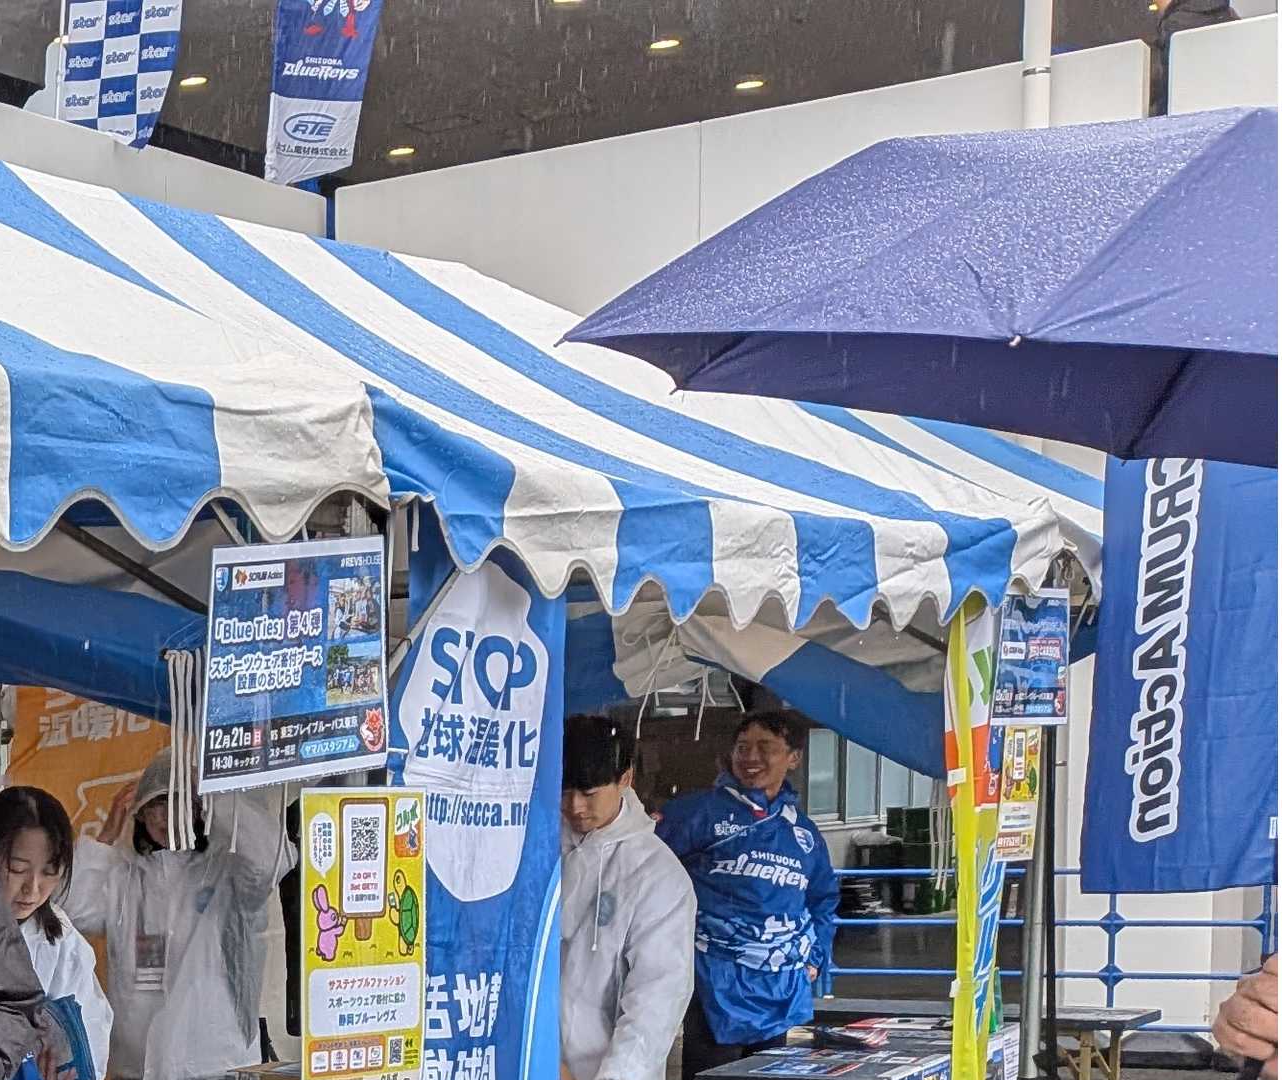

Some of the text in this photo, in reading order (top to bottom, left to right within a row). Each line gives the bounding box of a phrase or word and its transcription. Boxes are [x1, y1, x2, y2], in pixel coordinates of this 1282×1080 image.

[750, 850, 802, 869] SHIZUOKA
[338, 1009, 397, 1026] 静岡ブルーレヴズ
